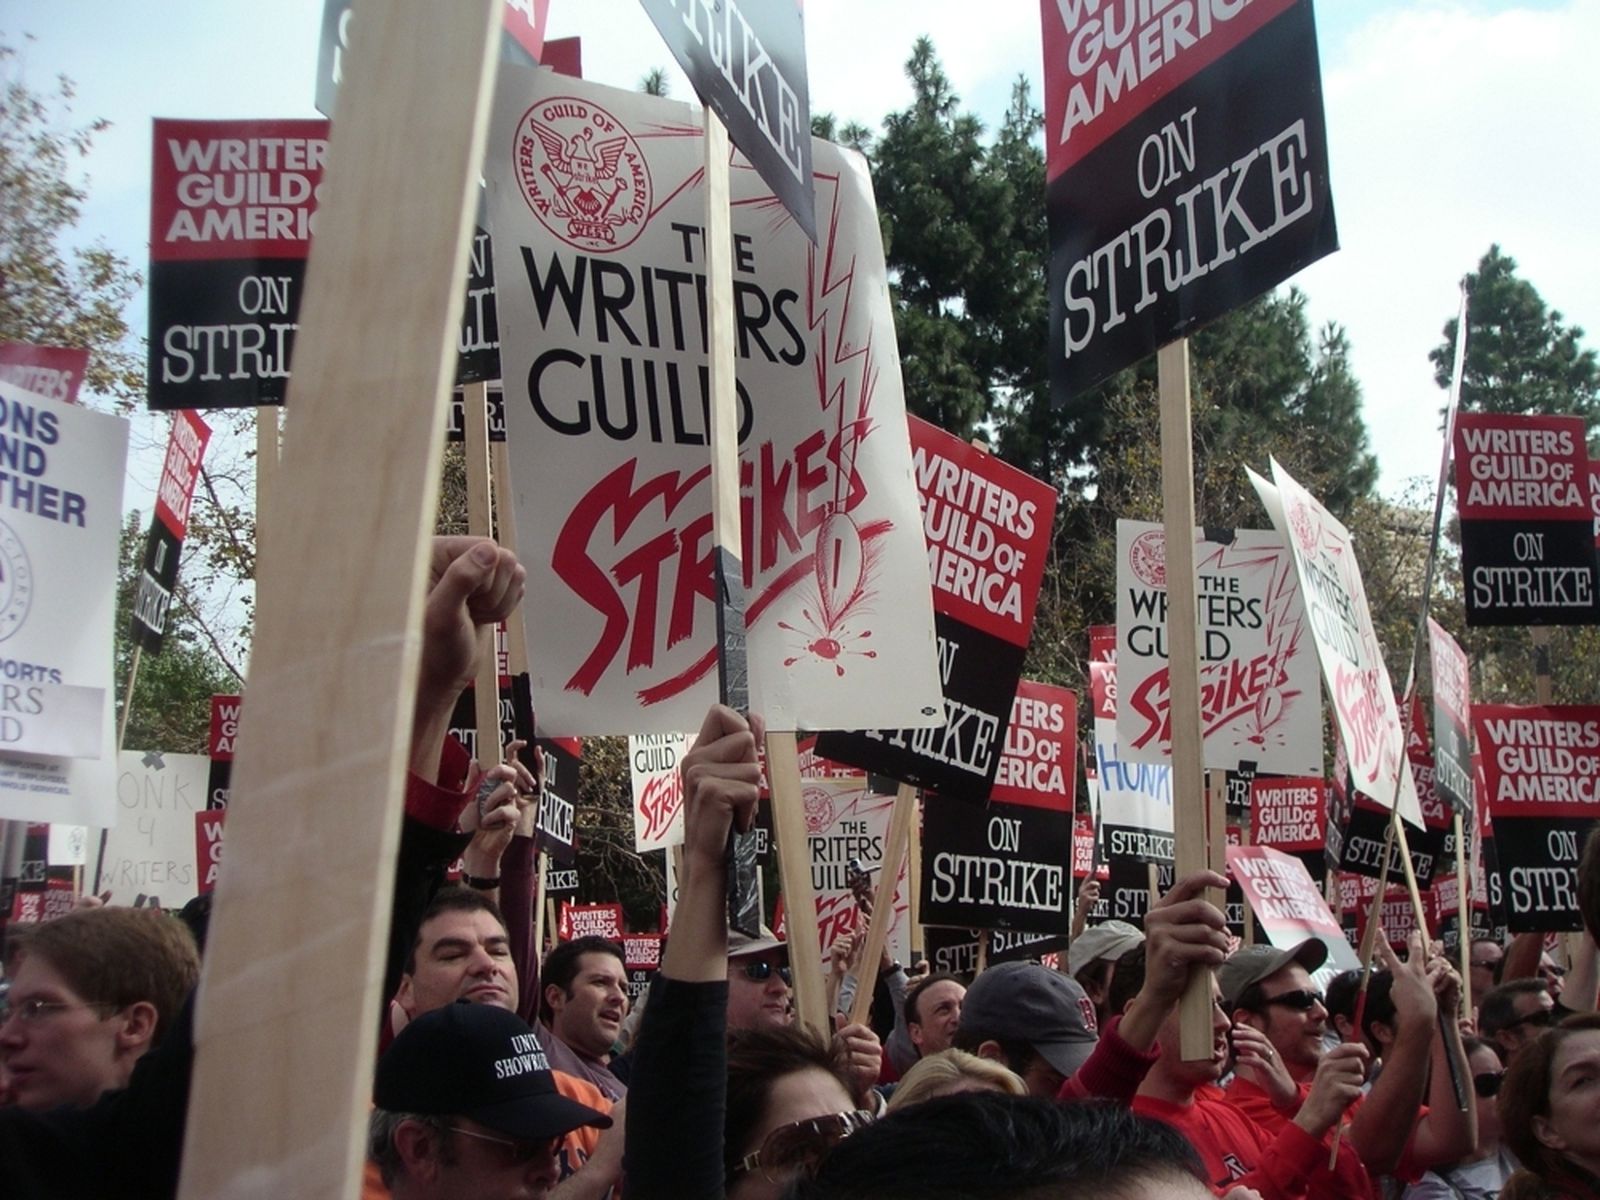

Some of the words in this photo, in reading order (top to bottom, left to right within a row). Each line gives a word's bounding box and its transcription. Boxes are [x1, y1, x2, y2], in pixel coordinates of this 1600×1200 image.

[543, 104, 588, 122] GUILD
[593, 113, 615, 133] OF
[1137, 107, 1197, 199] ON
[176, 173, 312, 208] GUILD
[165, 207, 316, 243] AMERI
[1064, 118, 1313, 359] STRIKE
[672, 222, 756, 274] TE
[238, 275, 292, 316] ON
[162, 322, 298, 384] STRI
[1461, 428, 1575, 456] WRITERS
[1470, 454, 1548, 481] GUILD
[1550, 462, 1573, 481] OF
[912, 447, 1037, 540] WRITERS
[1466, 481, 1584, 507] AMERICA
[993, 543, 1027, 578] OF
[1513, 532, 1544, 561] ON
[1472, 566, 1593, 608] STRIKE
[1484, 719, 1600, 748] WRITERS
[635, 747, 676, 773] GUILD
[1036, 740, 1061, 763] OF
[1497, 746, 1574, 775] GUILD
[1256, 787, 1318, 807] WRITERS
[840, 821, 868, 835] THE
[1259, 807, 1302, 826] GUILD
[1303, 810, 1317, 824] OF
[988, 816, 1023, 853] ON
[1256, 824, 1321, 844] AMERICA
[1548, 830, 1578, 862] ON
[807, 836, 883, 862] RITERS
[101, 858, 193, 886] WRITERS
[930, 850, 1063, 913] STRIKE
[569, 909, 616, 921] WRITERS
[573, 920, 604, 931] GUILD
